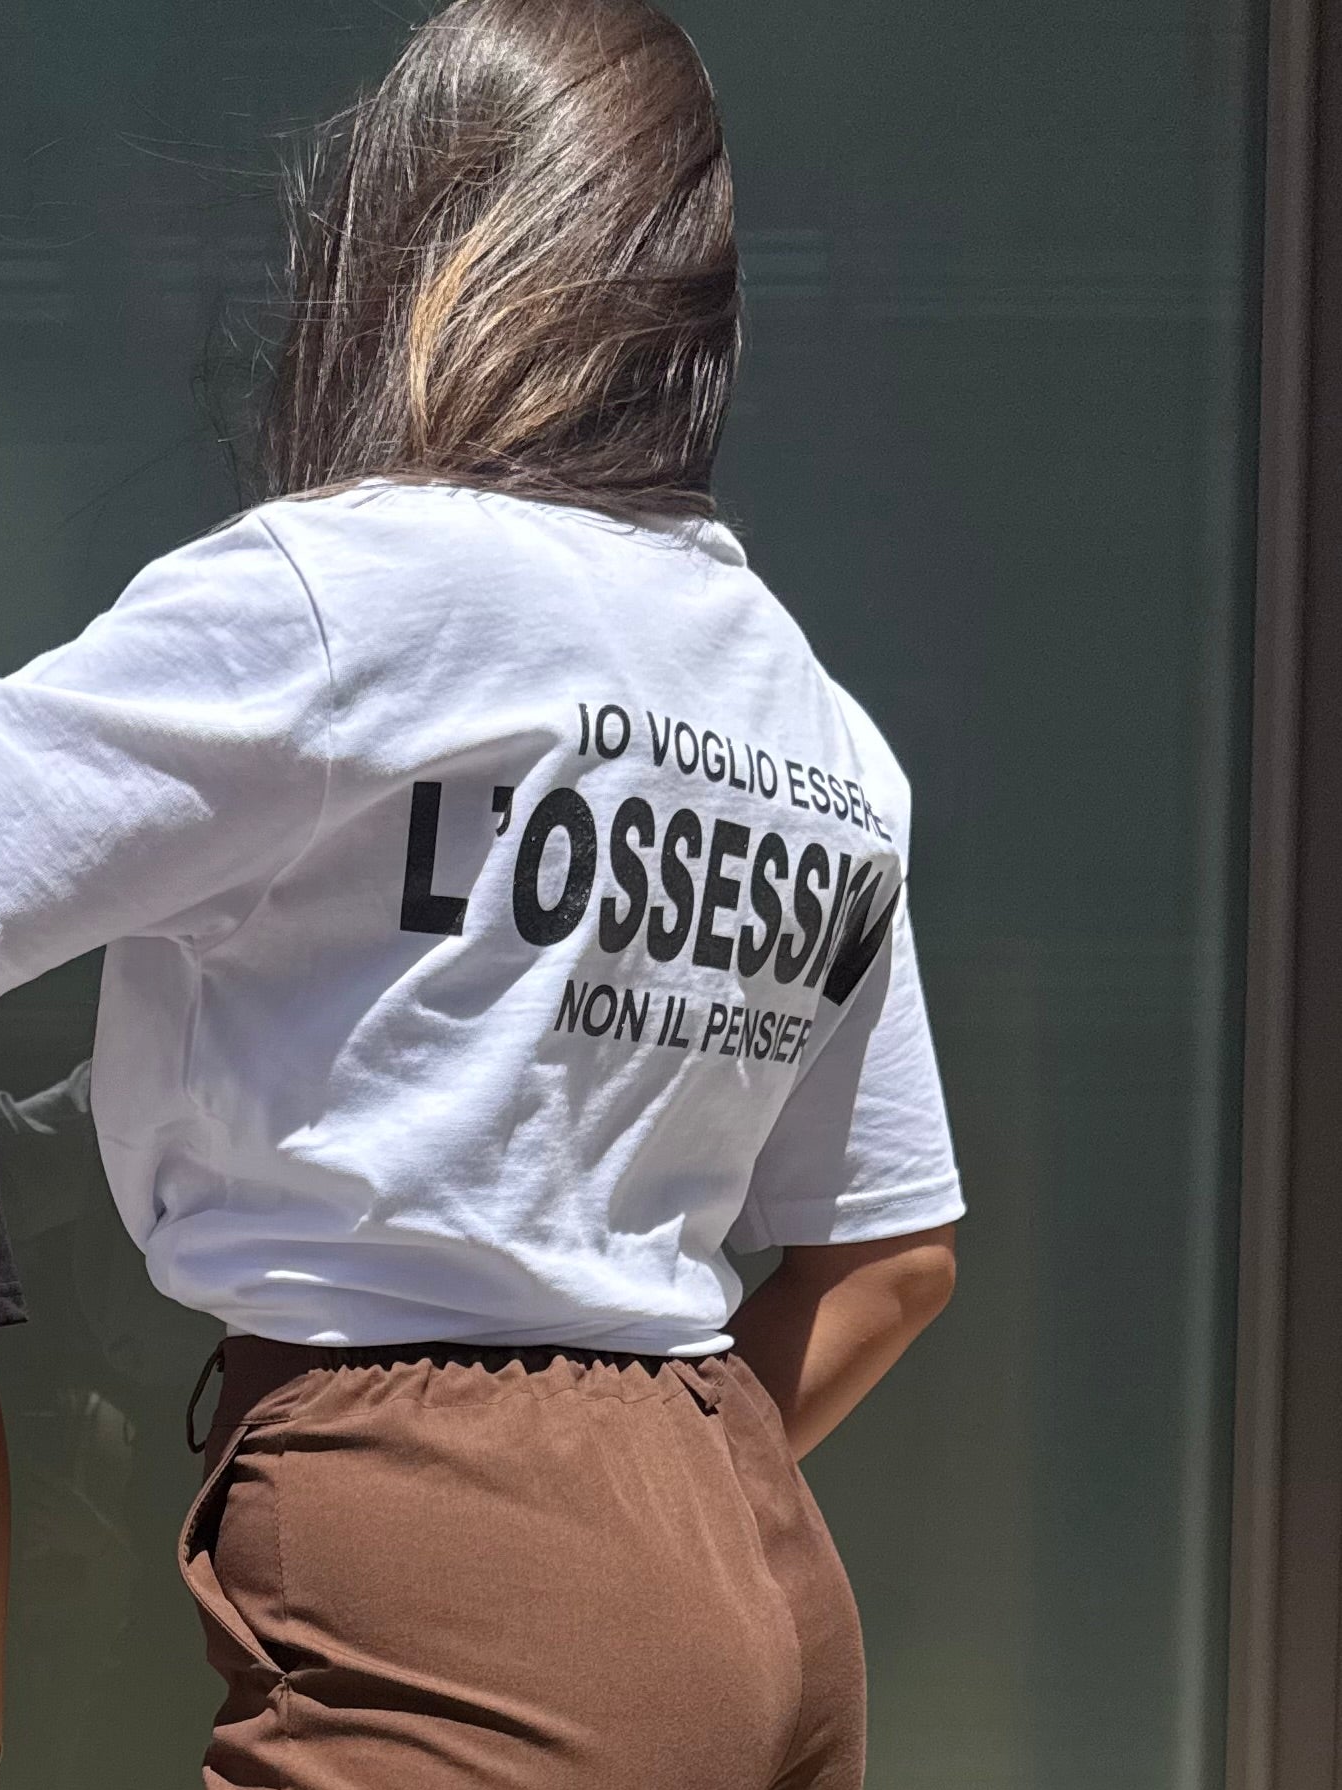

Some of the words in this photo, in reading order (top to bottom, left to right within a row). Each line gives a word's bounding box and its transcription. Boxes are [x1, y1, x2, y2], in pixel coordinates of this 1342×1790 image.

[578, 702, 631, 760] IO
[646, 711, 778, 800] VOGLIO
[785, 759, 893, 843] ESSERE
[553, 979, 651, 1042] NON
[657, 995, 690, 1050] IL
[700, 1002, 813, 1065] PENSIER
